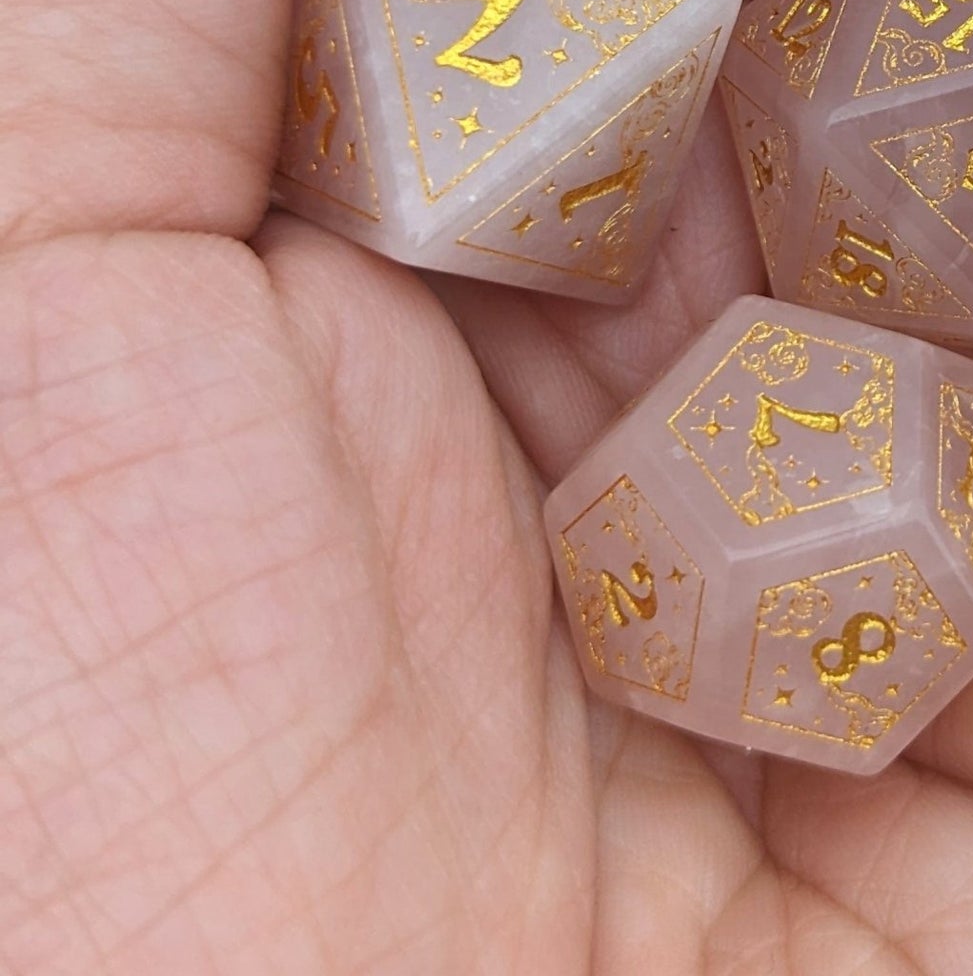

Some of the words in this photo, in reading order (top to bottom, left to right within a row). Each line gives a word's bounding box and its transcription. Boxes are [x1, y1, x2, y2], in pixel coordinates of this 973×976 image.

[559, 149, 651, 224] 1
[830, 218, 896, 300] 18
[748, 392, 843, 448] 7
[600, 560, 660, 628] 2
[810, 611, 898, 685] 8
